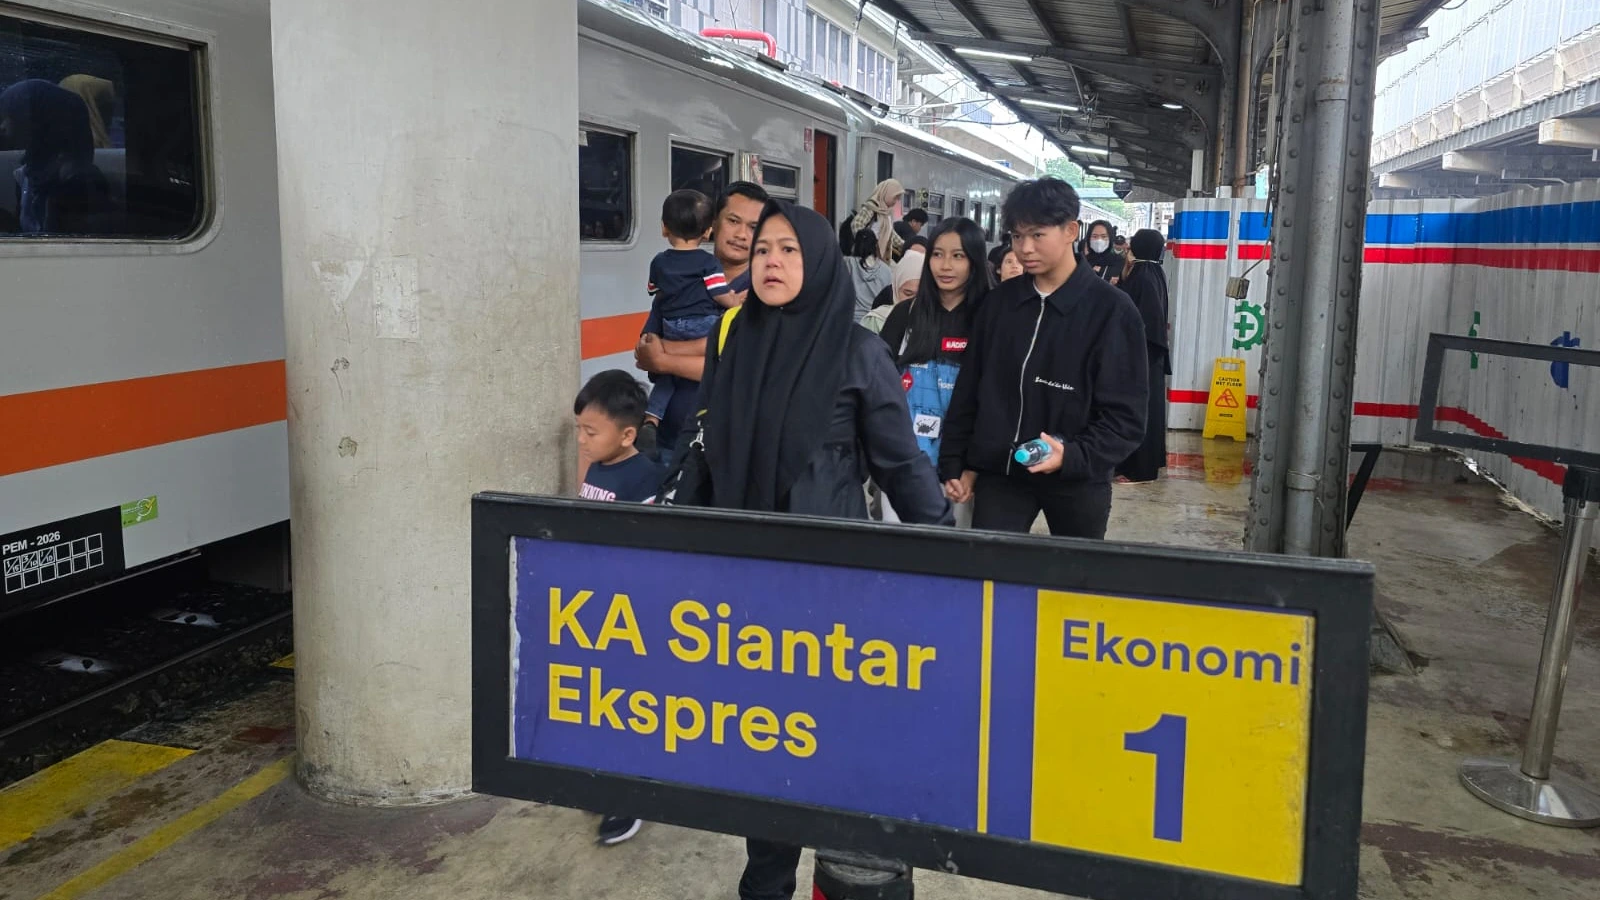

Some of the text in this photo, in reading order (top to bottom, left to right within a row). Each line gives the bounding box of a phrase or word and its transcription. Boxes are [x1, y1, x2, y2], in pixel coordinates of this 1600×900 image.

[2, 539, 28, 555] PEM
[36, 531, 61, 546] 2026
[549, 587, 937, 690] KA Siantar
[1062, 618, 1301, 686] Ekonomi
[548, 663, 818, 758] Ekspres
[1123, 713, 1187, 843] 1
